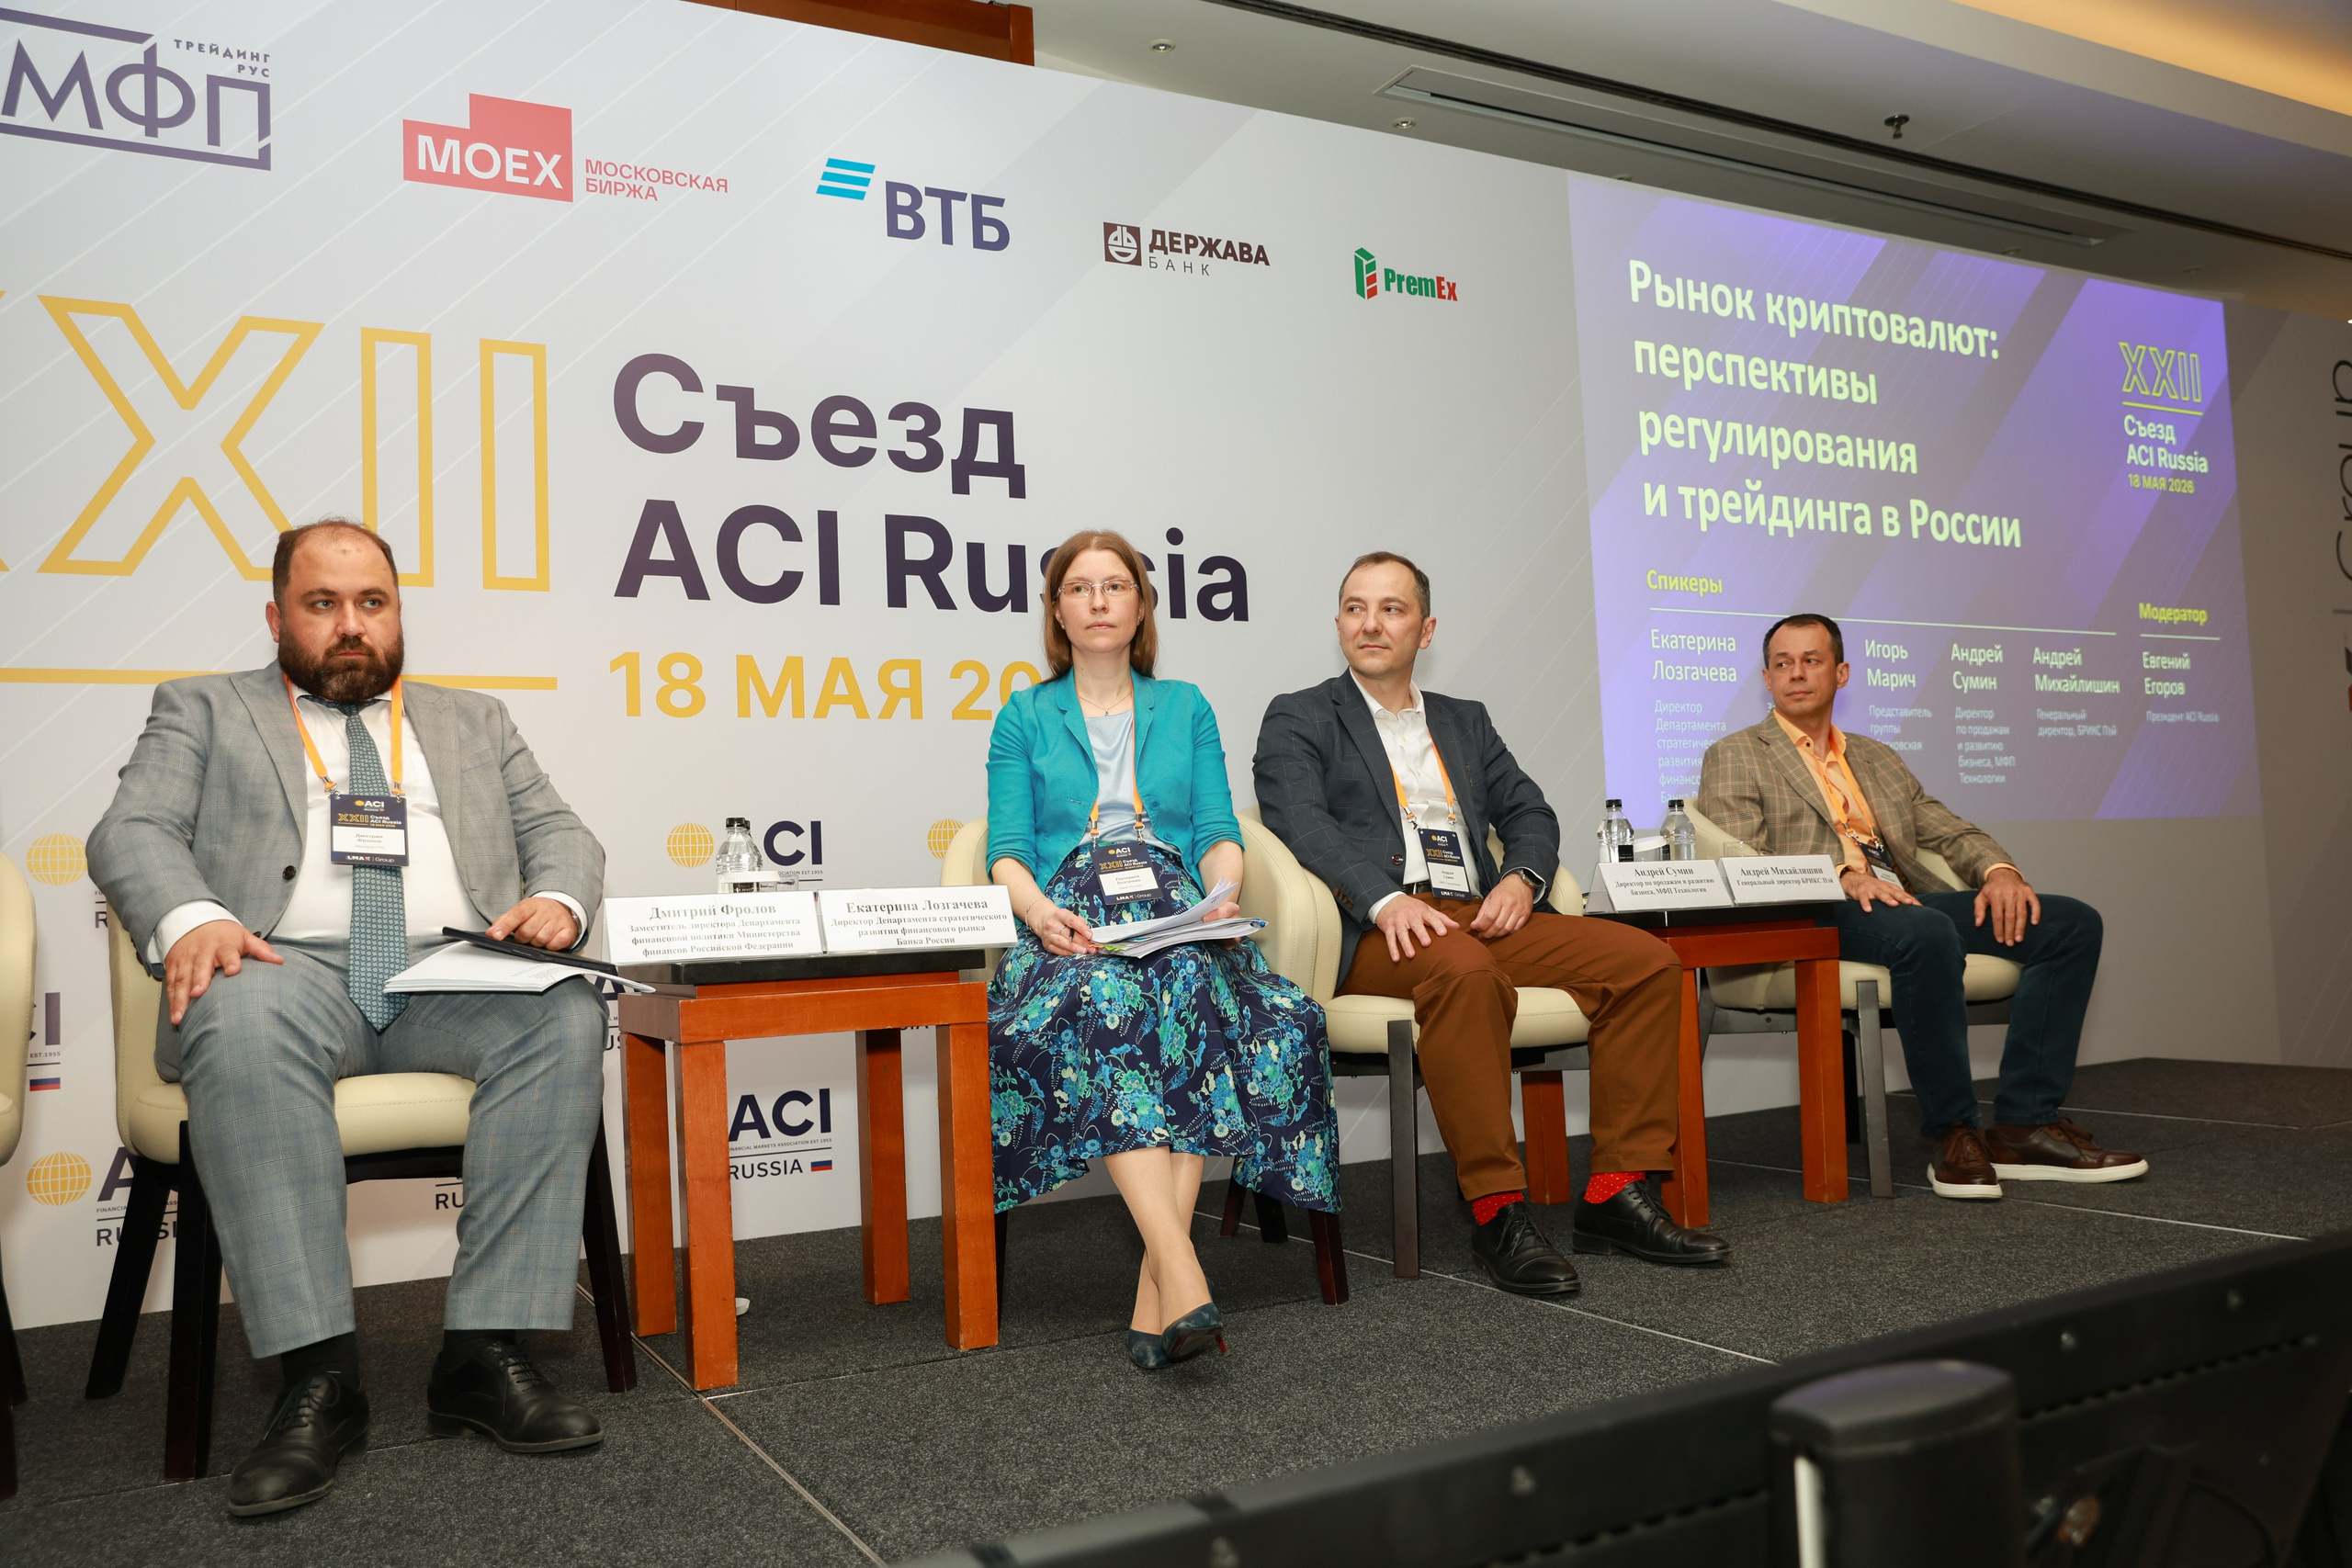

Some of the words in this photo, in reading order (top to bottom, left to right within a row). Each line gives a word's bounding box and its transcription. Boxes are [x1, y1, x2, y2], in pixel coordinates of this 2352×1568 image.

[174, 39, 270, 63] ТРЕЙДИНГ
[237, 63, 270, 78] РУС
[1, 39, 271, 147] МФП
[417, 134, 563, 189] MOEX
[584, 159, 729, 194] МОСКОВСКАЯ
[584, 177, 659, 201] БИРЖА
[885, 180, 1011, 253] ВТБ
[1148, 229, 1271, 266] ДЕРЖАВА
[1148, 255, 1210, 276] БАНК
[1384, 267, 1458, 301] PremEx
[1629, 259, 1756, 321] Рынок
[1766, 292, 1999, 359] криптовалют:
[1634, 340, 1877, 404] перспективы
[2118, 341, 2202, 402] XXII
[613, 353, 1027, 499] Съезд
[2123, 414, 2177, 446] Съезд
[0, 290, 549, 592] XII
[1639, 411, 1917, 474] регулирования
[2126, 444, 2155, 467] ACI
[2157, 446, 2209, 473] Russia
[2128, 473, 2141, 489] 18
[2142, 475, 2167, 491] МАЯ
[2168, 478, 2195, 494] 2026
[1644, 482, 1668, 517] и
[1678, 479, 1871, 537] трейдинга
[1882, 505, 1901, 536] в
[1909, 498, 2021, 548] России
[614, 499, 840, 605] ACI
[1646, 570, 1723, 597] Спикеры
[2139, 603, 2209, 626] Модератор
[1650, 628, 1736, 655] Екатерина
[1865, 639, 1908, 663] Игорь
[1951, 643, 2004, 667] Андрей
[2032, 647, 2083, 670] Андрей
[2143, 651, 2191, 671] Евгений
[1652, 660, 1737, 682] Лозгачева
[1867, 668, 1917, 692] Марич
[609, 651, 707, 718] 18
[736, 653, 922, 720] МАЯ
[949, 659, 1044, 720] 20
[1952, 671, 1998, 694] Сумин
[2034, 674, 2120, 694] Михайлишин
[2144, 677, 2187, 698] Егоров
[1655, 700, 1702, 716] Директор
[1869, 705, 1933, 719] Представитель
[1955, 706, 1995, 721] Директор
[2036, 708, 2087, 722] Генеральный
[1656, 717, 1726, 733] Департамента
[1870, 724, 1901, 736] группы
[1956, 726, 1967, 735] по
[1968, 726, 2010, 738] продажам
[1964, 742, 2005, 753] развитию
[1657, 756, 1702, 770] развития
[1995, 756, 2017, 767] МФП
[1659, 773, 1701, 787] финансо
[1959, 773, 2006, 784] Технологии
[337, 813, 369, 823] XXII
[763, 820, 823, 866] CI
[1634, 867, 1665, 878] Андрей
[1666, 866, 1694, 877] Сумин
[1740, 867, 1770, 877] Андрей
[1770, 866, 1824, 876] Михайлишин
[649, 905, 717, 920] Дмитрий
[720, 904, 776, 919] Фролов
[846, 901, 919, 916] Екатерина
[922, 899, 989, 912] Лозгачева
[628, 922, 687, 933] Заместитель
[689, 920, 736, 931] директора
[738, 919, 801, 930] Департамента
[831, 918, 874, 929] Директор
[876, 915, 937, 926] Департамента
[939, 913, 1008, 923] стратегического
[858, 927, 899, 938] развития
[900, 924, 956, 936] финансового
[957, 924, 986, 934] рынка
[631, 933, 688, 946] финансовой
[691, 932, 734, 942] политики
[737, 929, 801, 941] Министерства
[897, 937, 923, 946] Банка
[925, 935, 956, 945] России
[642, 947, 688, 958] финансов
[690, 943, 742, 953] Российской
[744, 942, 794, 953] Федерации
[729, 1088, 831, 1142] ACI
[729, 1158, 803, 1179] RUSSIA
[96, 1205, 127, 1213] FINANCIA
